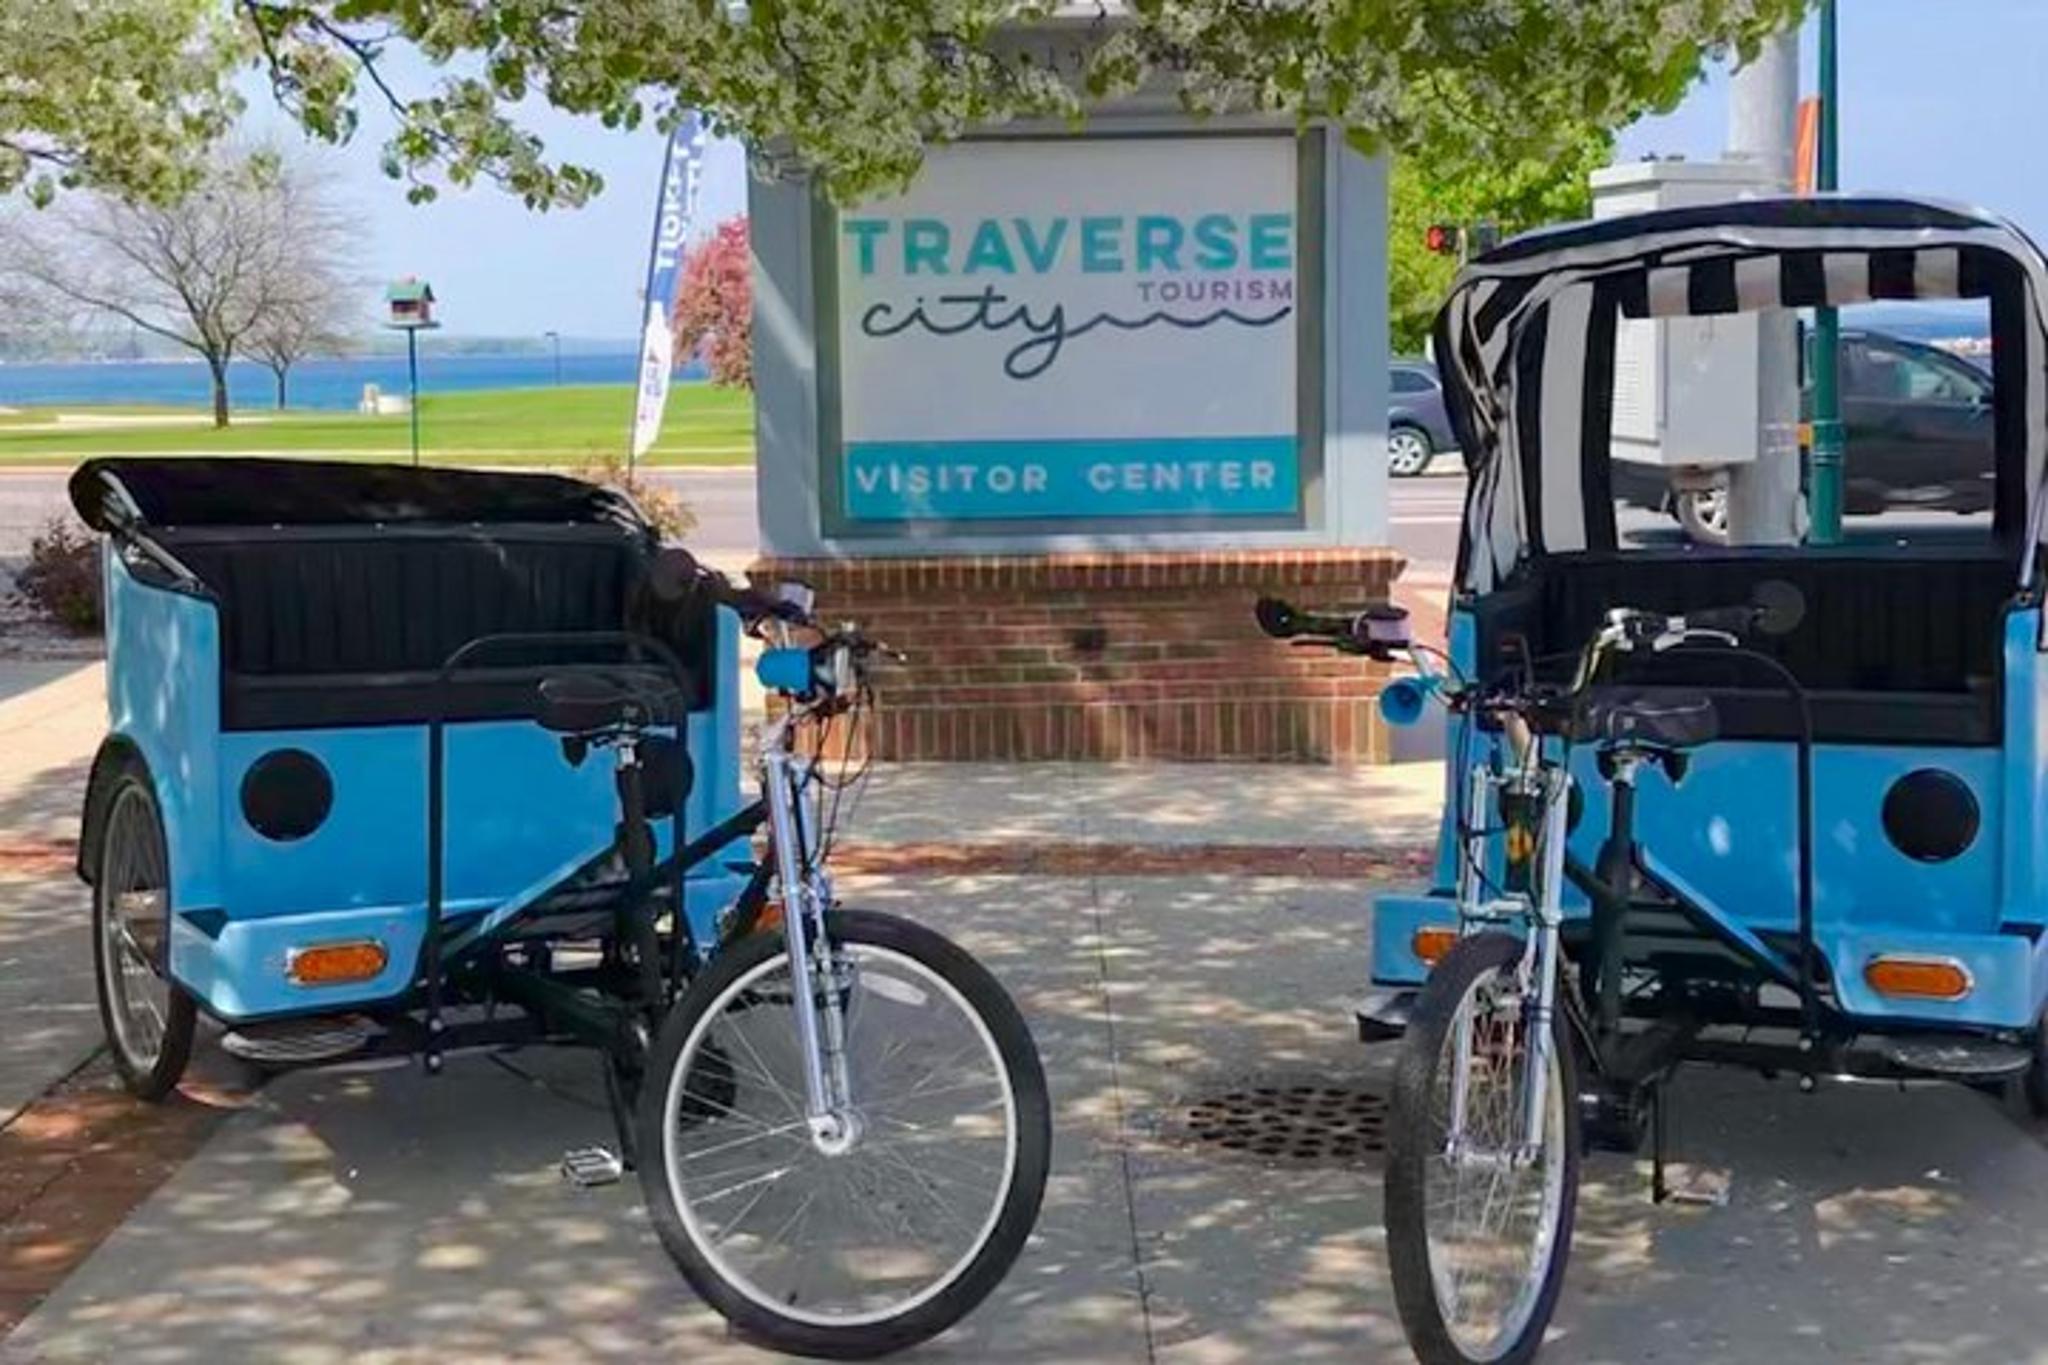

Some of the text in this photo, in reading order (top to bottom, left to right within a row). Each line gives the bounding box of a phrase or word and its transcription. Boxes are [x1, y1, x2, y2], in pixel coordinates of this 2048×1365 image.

[842, 214, 1293, 275] TRAVERSE
[1139, 279, 1293, 302] TOURISM
[855, 460, 1277, 493] VISITOR CENTER
